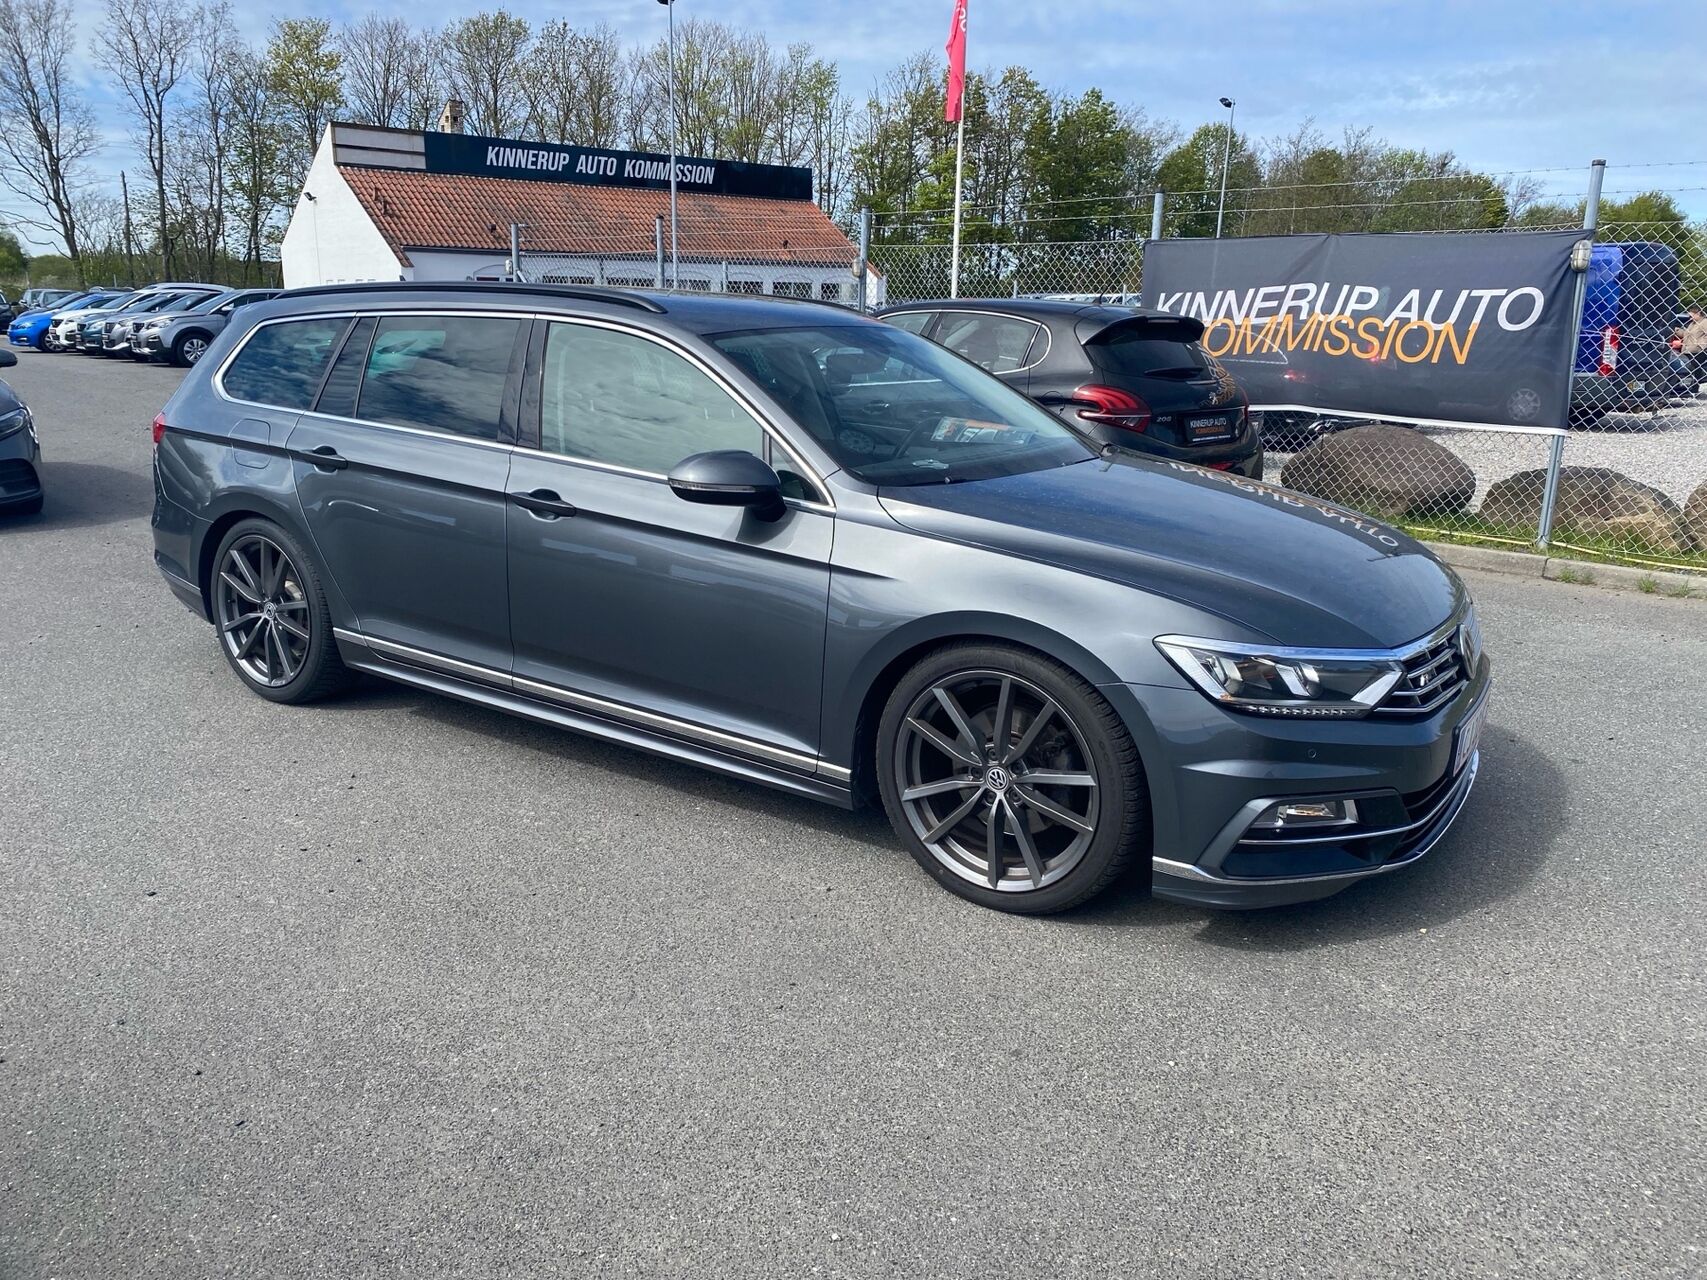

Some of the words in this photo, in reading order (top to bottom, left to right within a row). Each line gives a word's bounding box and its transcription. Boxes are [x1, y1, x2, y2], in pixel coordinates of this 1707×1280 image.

[486, 146, 569, 172] KINNERUP
[576, 155, 617, 176] AUTO
[624, 159, 716, 185] KOMMSSION
[1156, 282, 1380, 327] KINNERUP
[1383, 286, 1545, 332] AUTO
[1203, 312, 1479, 365] OMMISSION
